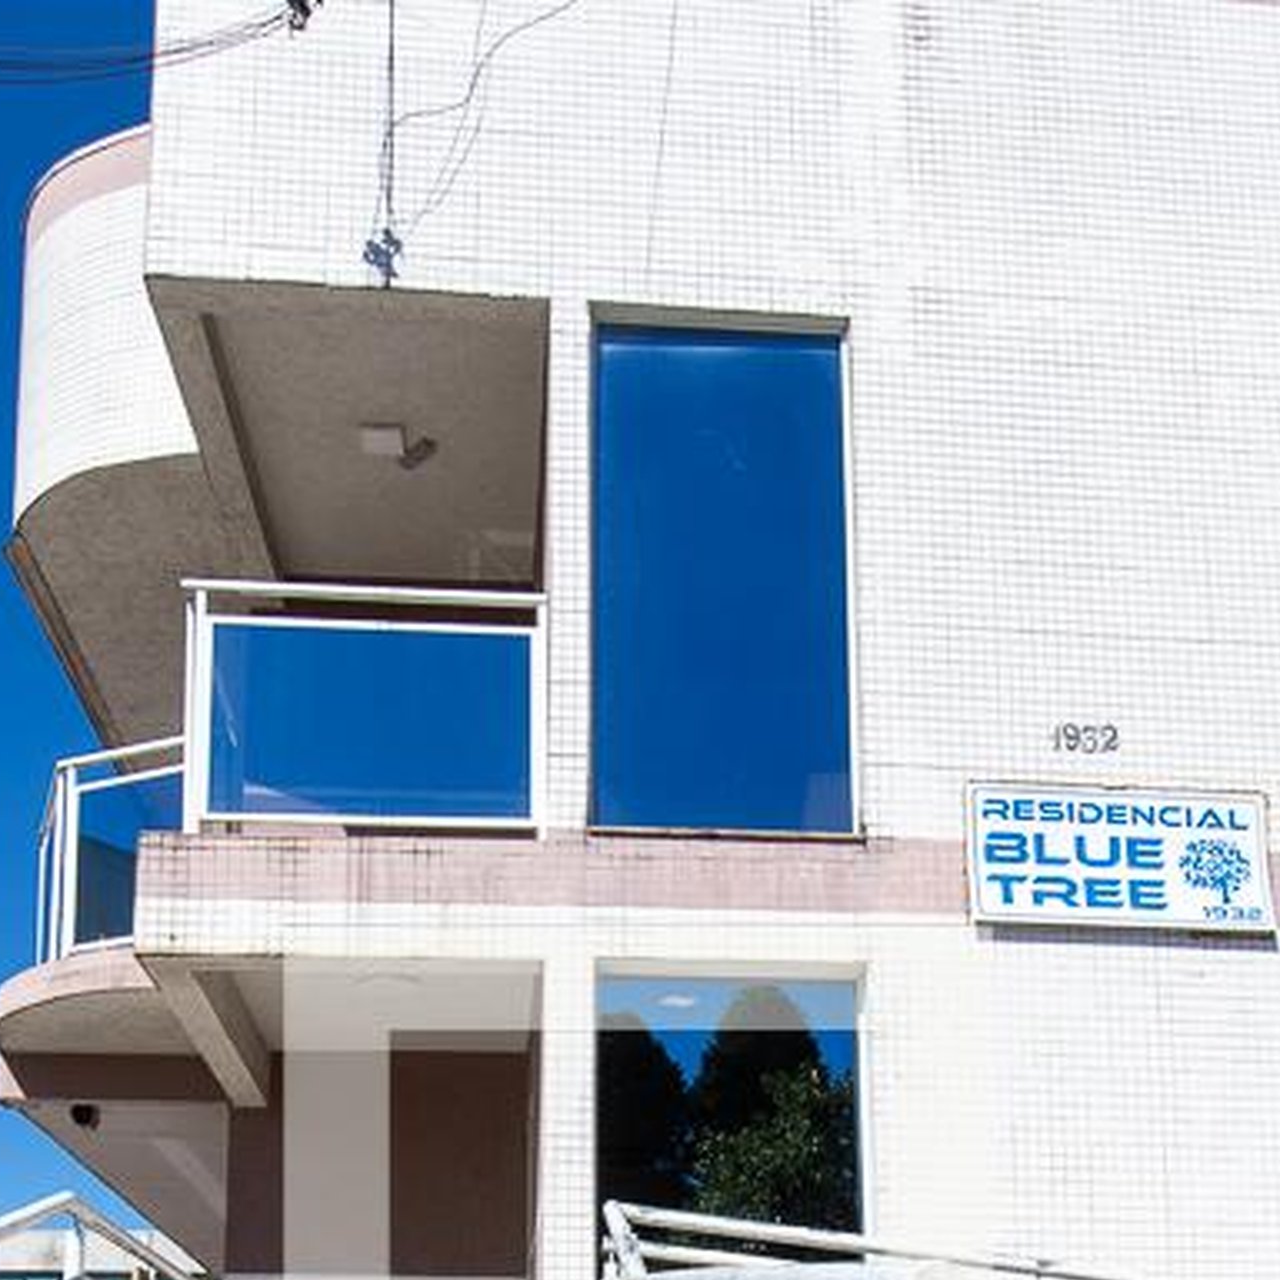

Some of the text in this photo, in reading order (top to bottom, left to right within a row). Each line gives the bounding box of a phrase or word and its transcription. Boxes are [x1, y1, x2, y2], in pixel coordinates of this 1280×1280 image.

[1052, 722, 1119, 754] 1932
[982, 799, 1250, 831] RESIDENCIAL
[984, 832, 1166, 870] BLUE
[986, 873, 1169, 911] TREE
